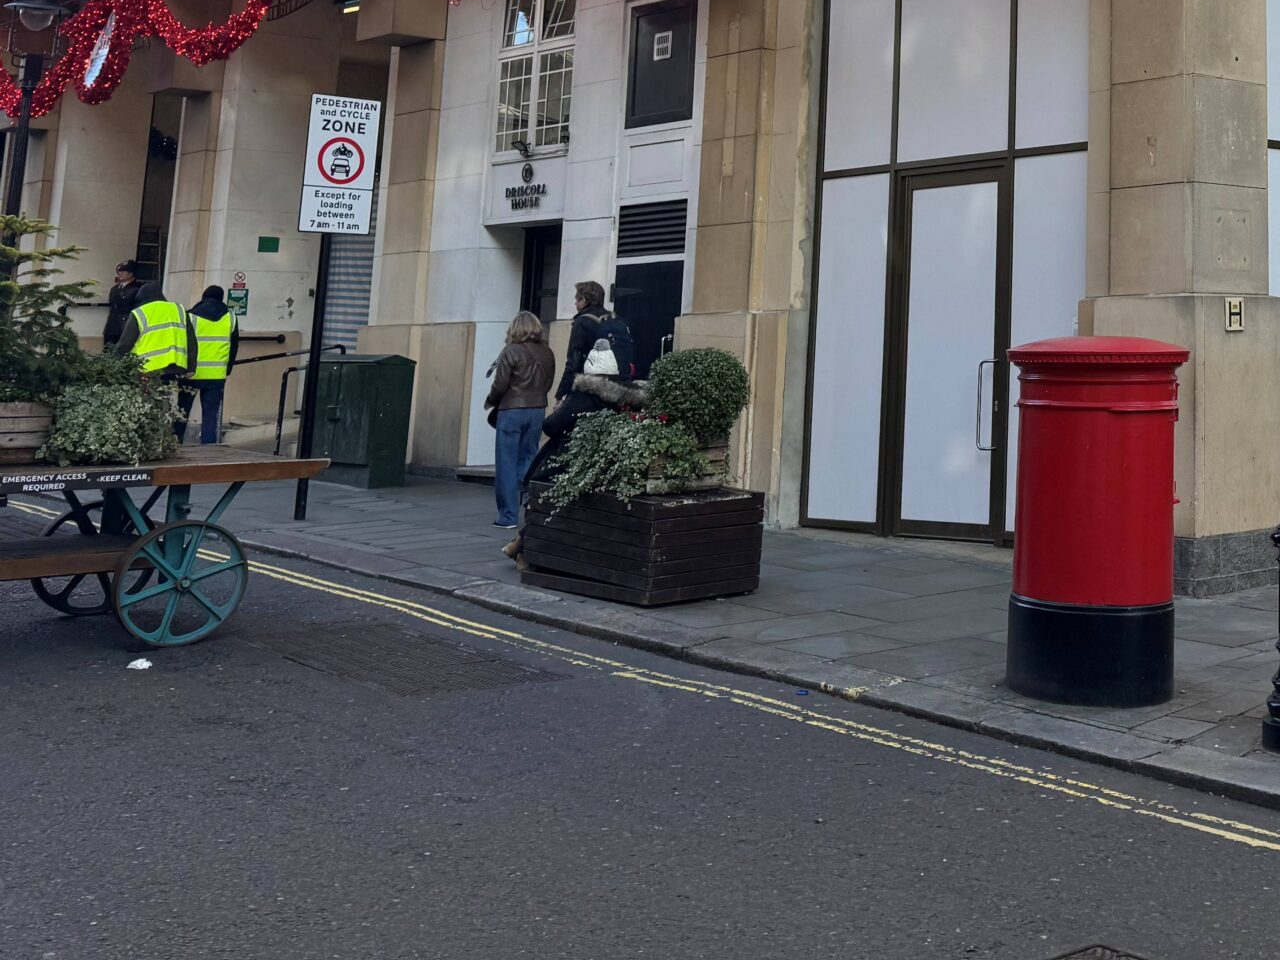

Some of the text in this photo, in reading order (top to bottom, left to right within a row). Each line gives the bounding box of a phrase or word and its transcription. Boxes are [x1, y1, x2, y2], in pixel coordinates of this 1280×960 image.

[315, 97, 378, 112] PEDESTRIAN
[320, 109, 371, 121] and CYCLE
[321, 119, 367, 135] ZONE
[314, 189, 361, 201] Except for
[505, 183, 547, 198] DRISCOLL
[320, 200, 354, 211] loading
[511, 196, 541, 210] HOUSE
[316, 209, 355, 220] between
[309, 220, 315, 228] 7
[346, 223, 360, 231] am
[1229, 301, 1242, 327] H
[2, 474, 54, 483] EMERGENCY
[56, 472, 87, 481] ACCESS
[100, 475, 120, 483] KEEP
[22, 483, 65, 491] REQUIRED
